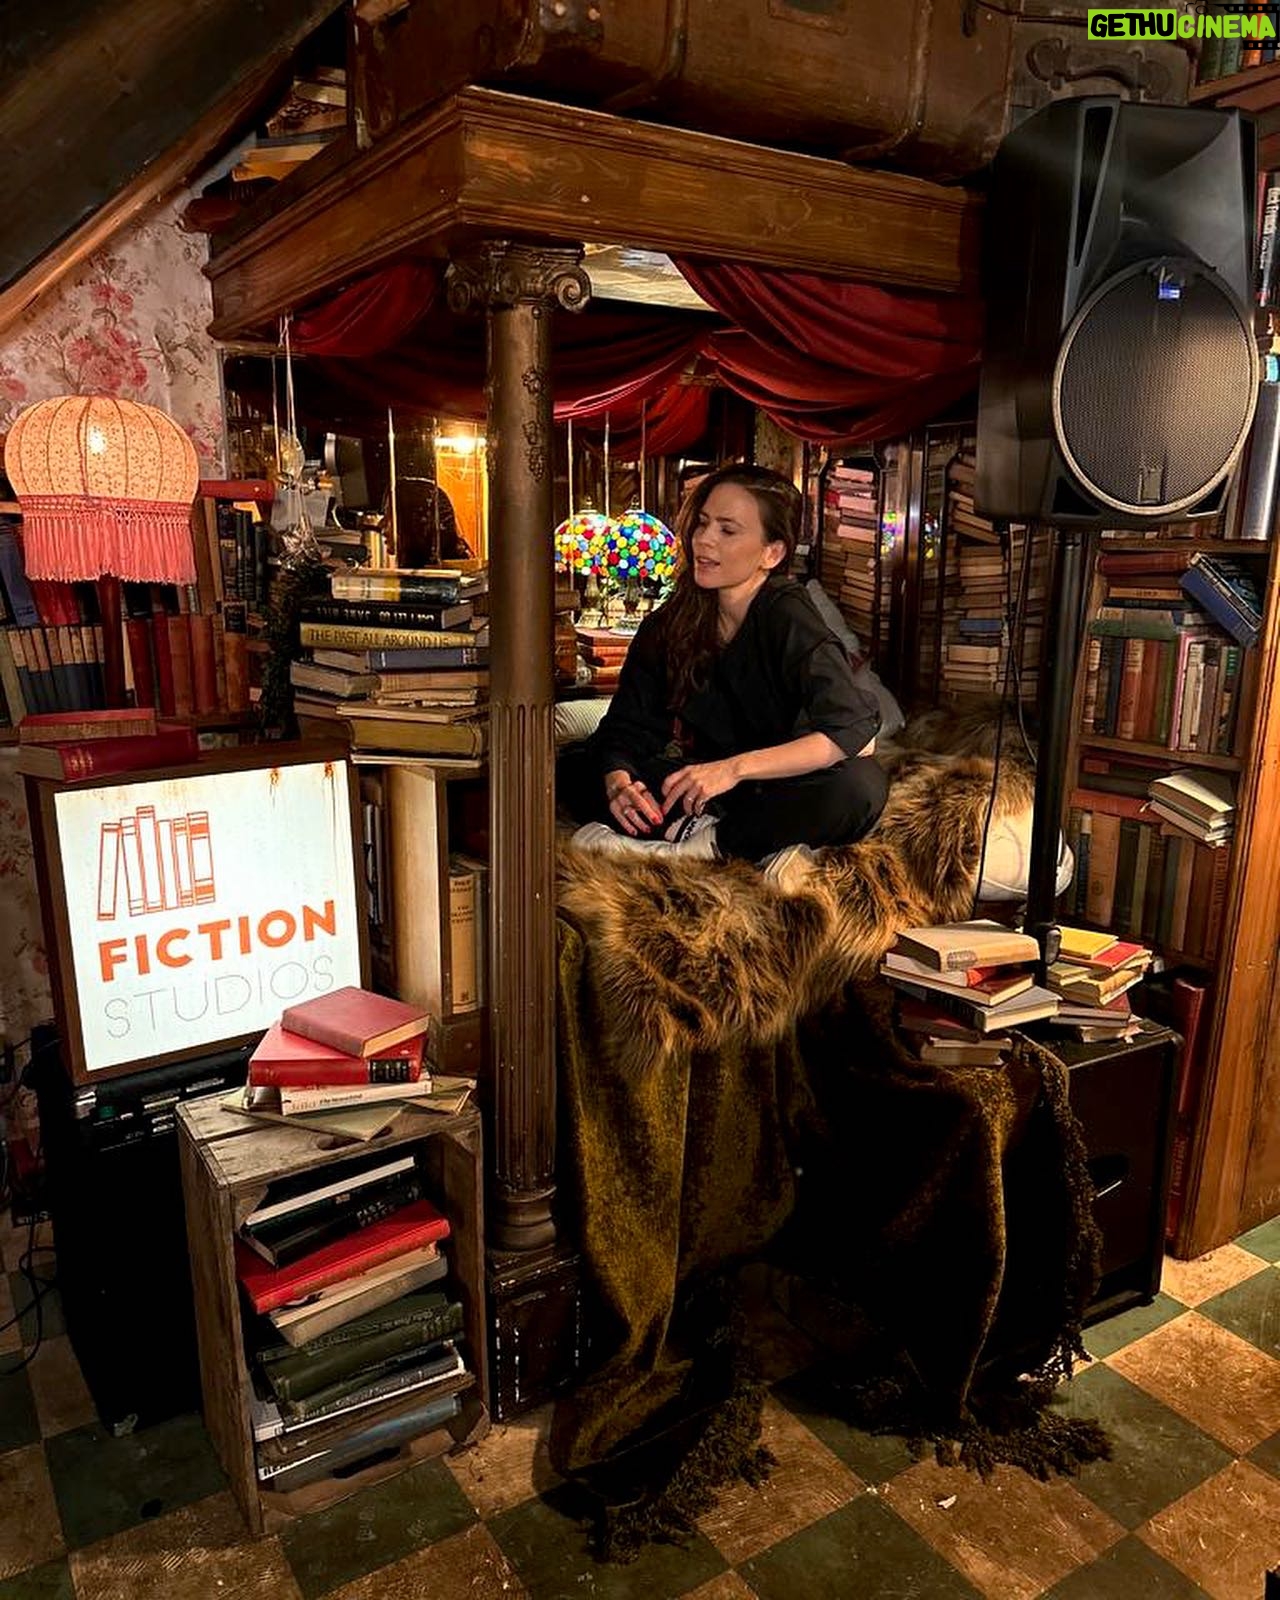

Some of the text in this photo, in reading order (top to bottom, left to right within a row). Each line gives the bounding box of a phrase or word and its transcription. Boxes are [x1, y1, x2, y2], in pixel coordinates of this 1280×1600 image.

[308, 627, 332, 642] THE
[334, 630, 359, 644] PAST
[362, 632, 380, 646] ALL
[384, 634, 431, 649] AROUND
[98, 900, 336, 983] FICTION
[104, 954, 335, 1038] STUDIOS
